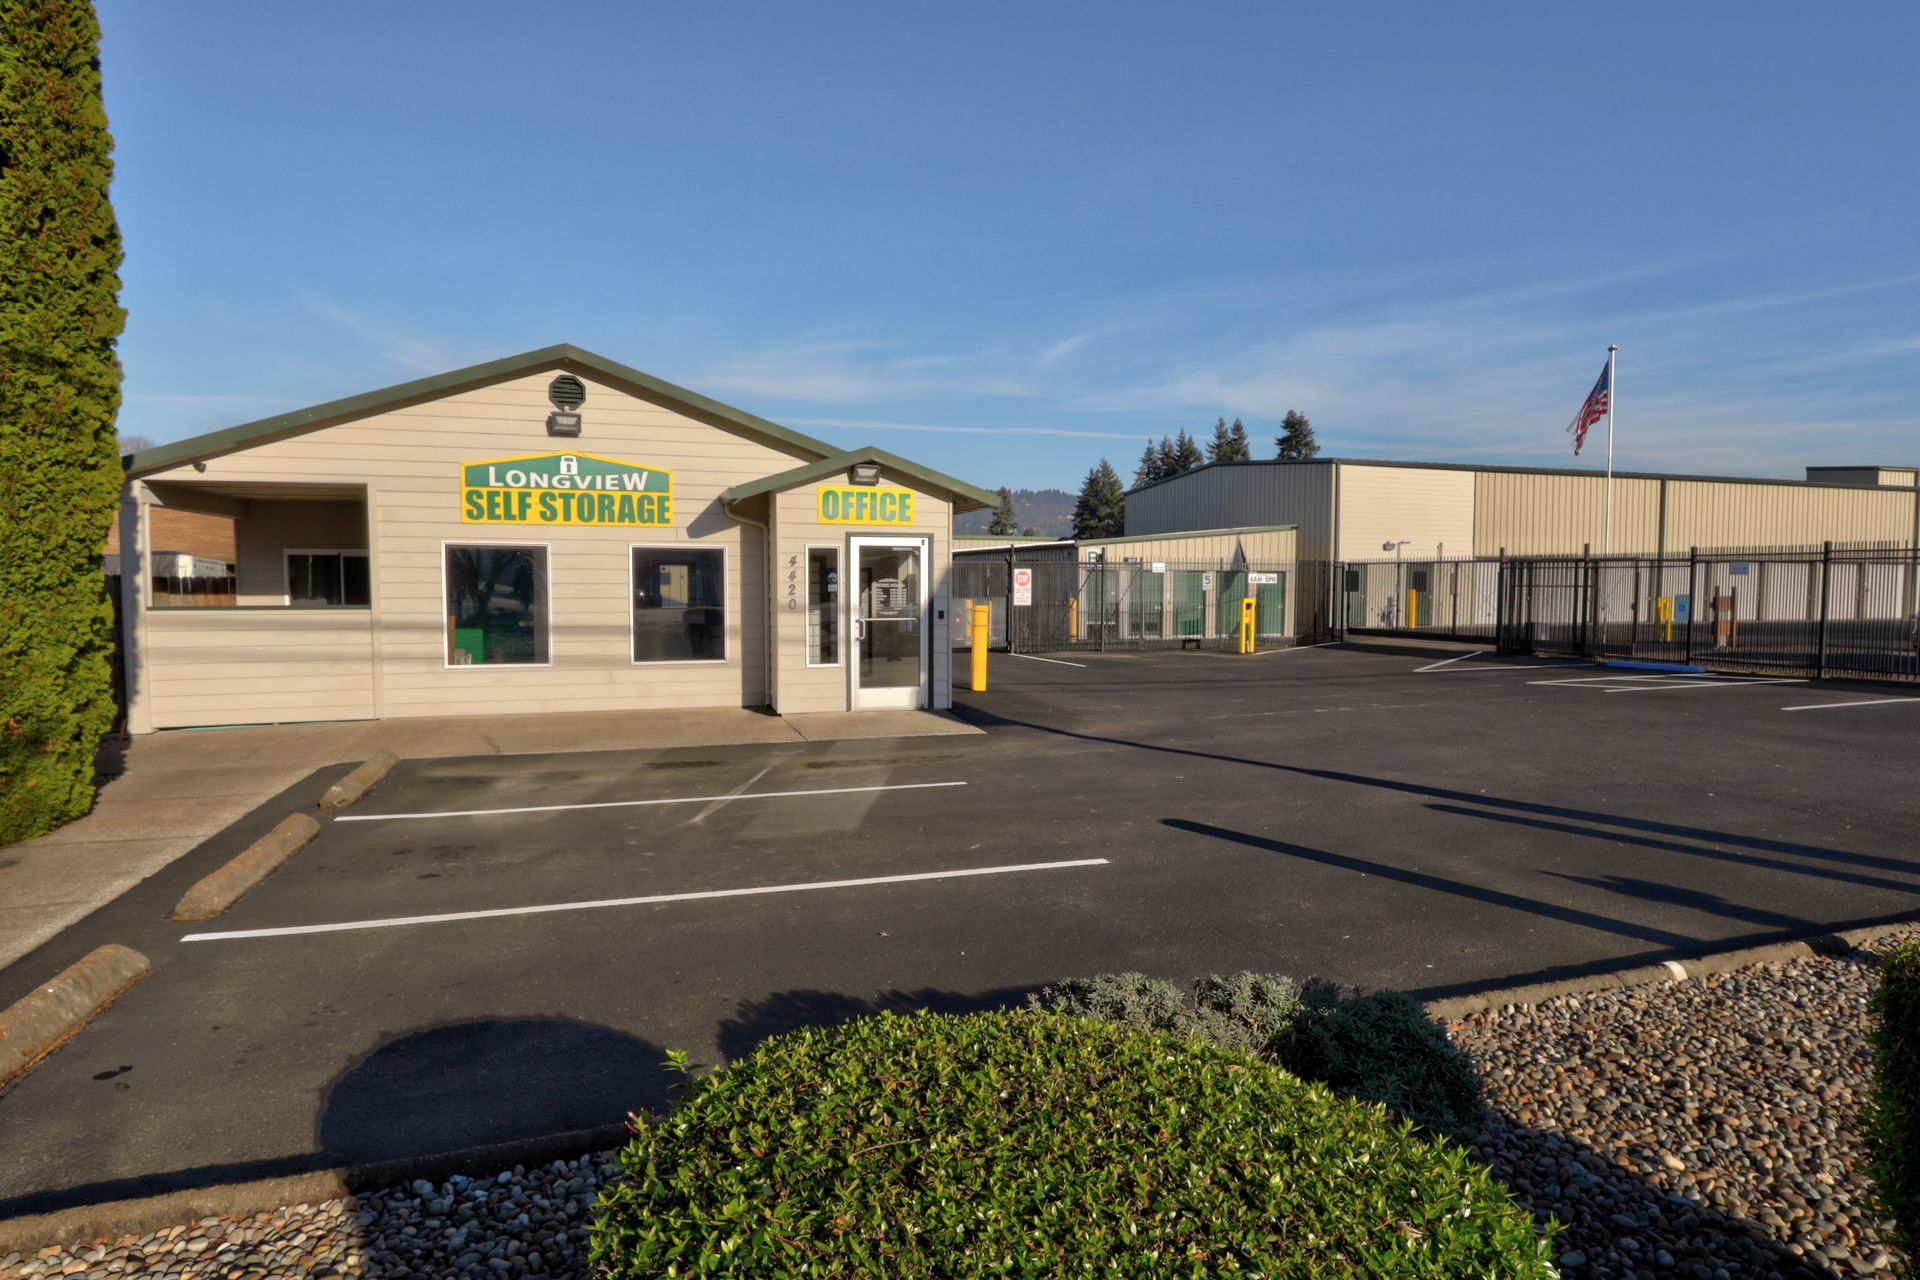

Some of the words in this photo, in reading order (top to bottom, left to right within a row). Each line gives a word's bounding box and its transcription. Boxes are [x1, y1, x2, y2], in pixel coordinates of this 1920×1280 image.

[489, 466, 648, 490] LONGVIEW
[465, 489, 532, 521] SELF
[538, 491, 671, 524] STORAGE
[822, 490, 911, 521] OFFICE
[788, 554, 798, 610] 4420
[1204, 575, 1211, 585] 5
